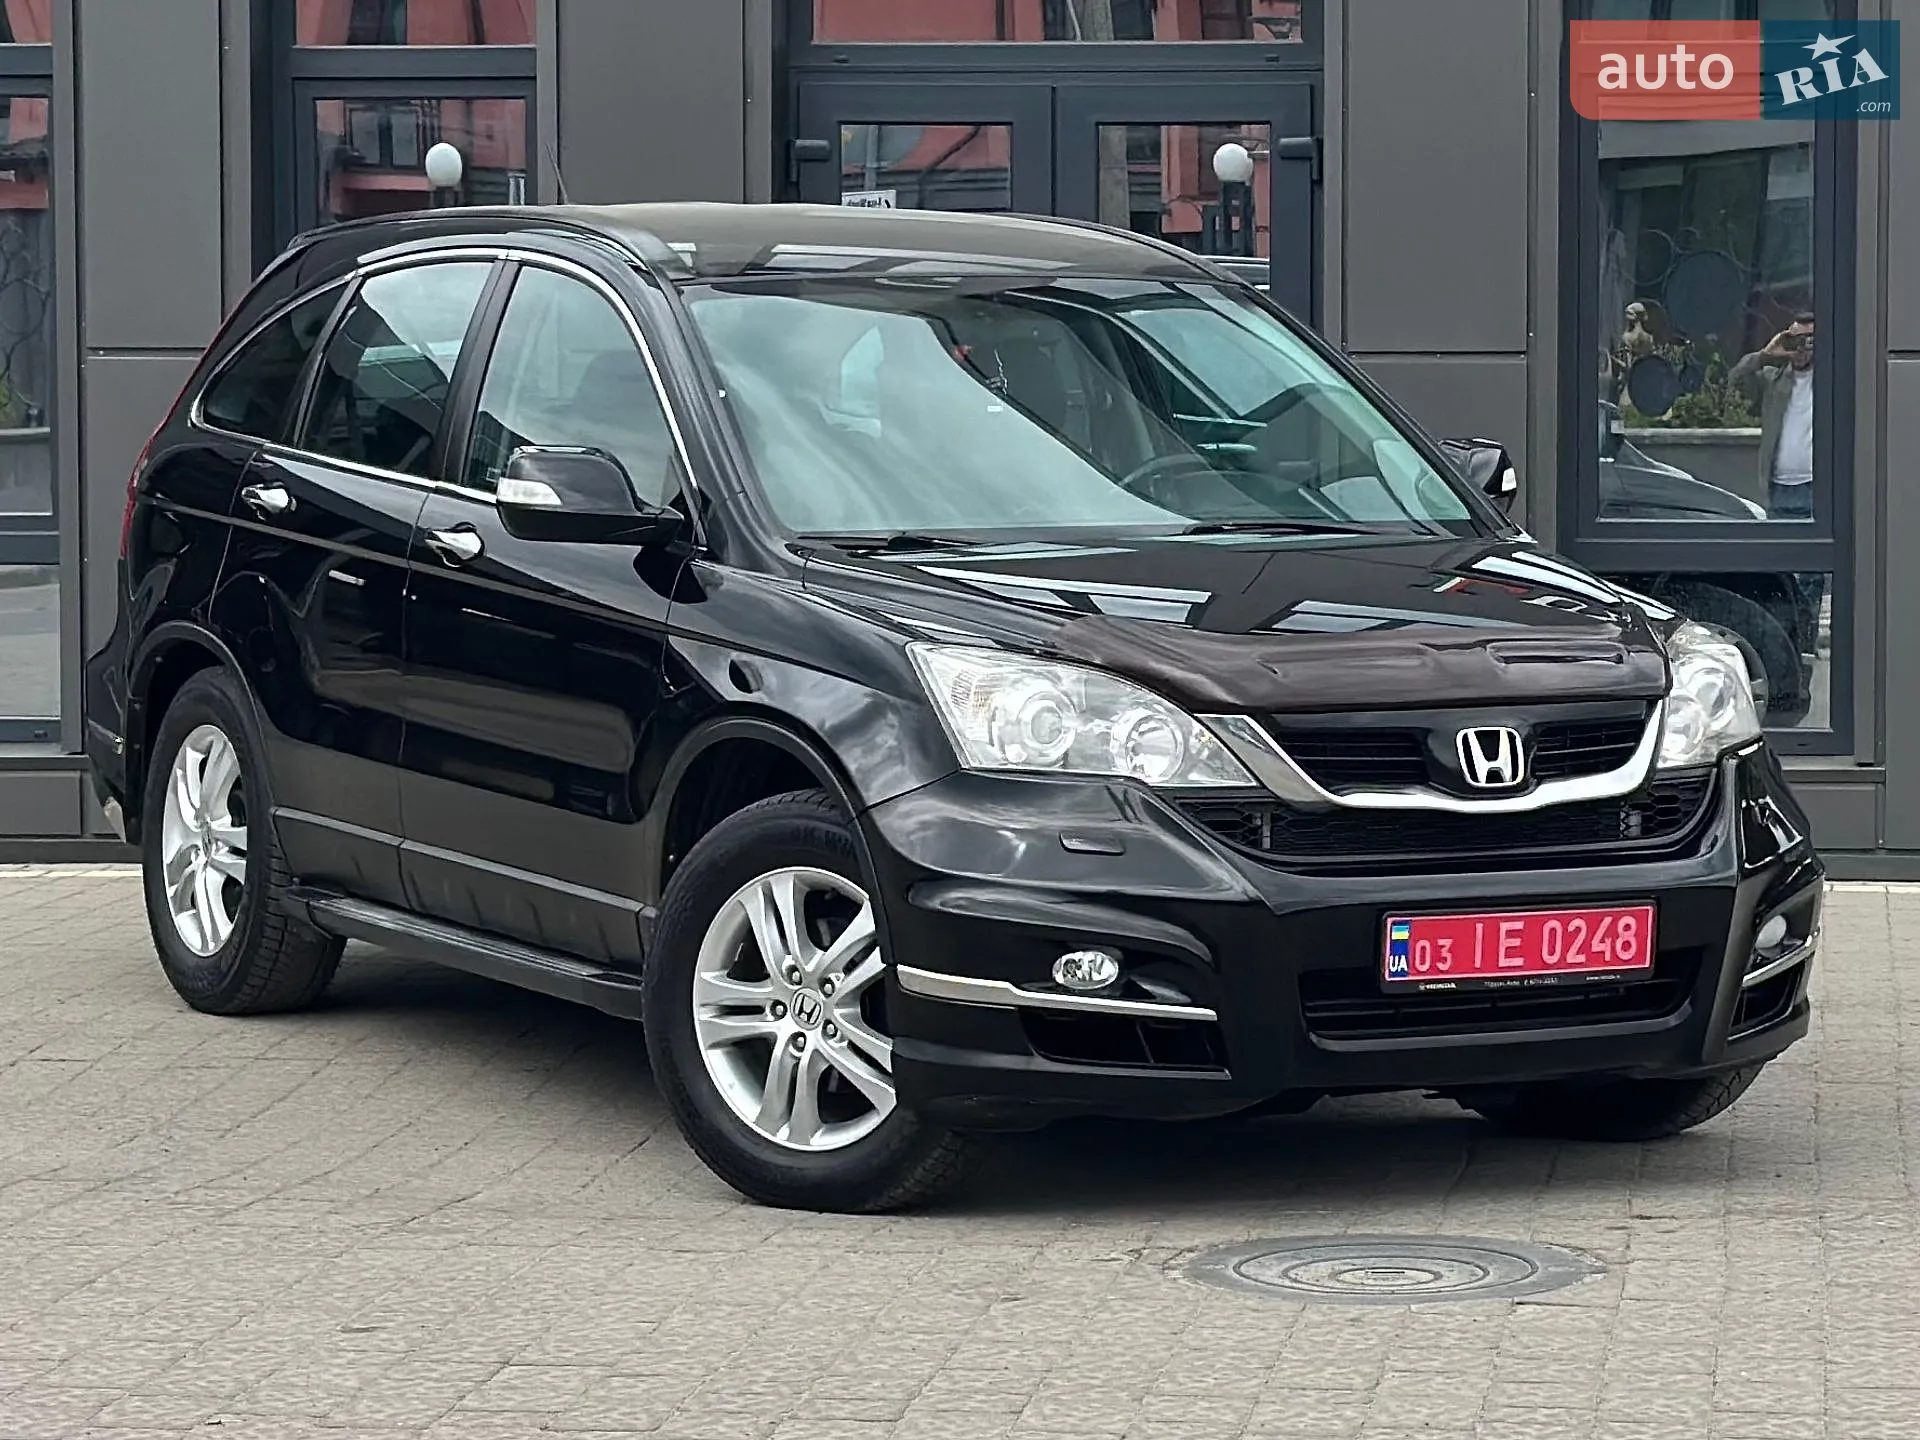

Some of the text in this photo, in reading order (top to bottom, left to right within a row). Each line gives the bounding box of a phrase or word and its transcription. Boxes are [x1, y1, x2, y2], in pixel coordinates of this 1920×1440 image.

[1414, 938, 1453, 972] 03
[1540, 915, 1638, 965] 0248
[1389, 954, 1408, 972] UA
